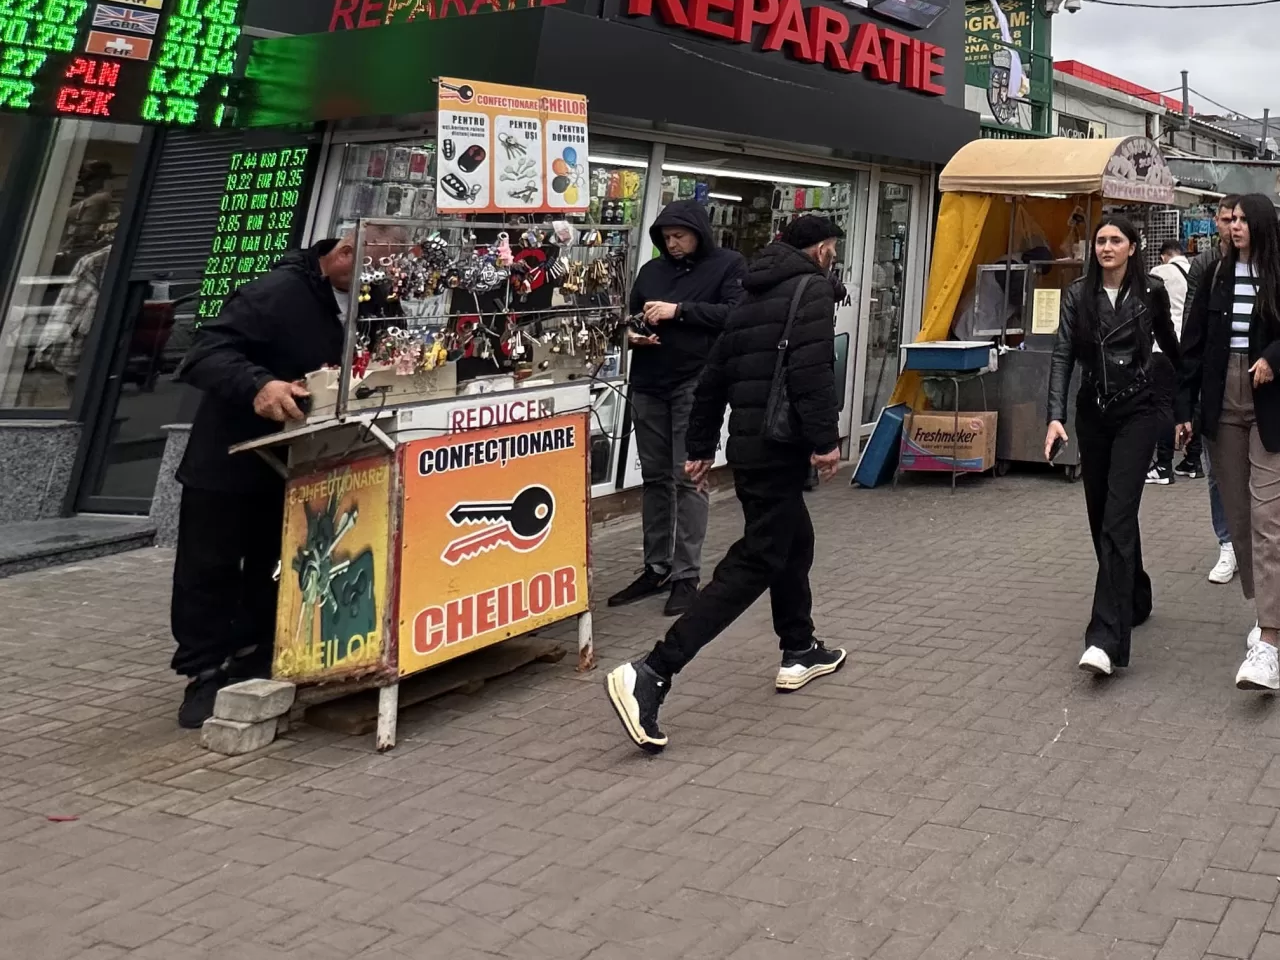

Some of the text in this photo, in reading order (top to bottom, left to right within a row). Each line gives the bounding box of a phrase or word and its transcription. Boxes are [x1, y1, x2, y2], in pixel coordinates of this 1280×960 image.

[965, 11, 1030, 32] GRM:
[110, 19, 141, 32] GBP
[166, 14, 242, 50] 22.87
[103, 46, 133, 57] CHF
[57, 86, 116, 117] CZK
[477, 95, 587, 115] CONFECȚIONARE CHEILOR
[452, 115, 485, 126] PENTRU
[509, 120, 538, 130] PENTRU
[559, 124, 585, 134] PENTRU
[525, 131, 537, 141] UȘI
[552, 134, 585, 143] DOMOFON
[230, 148, 309, 171] 17.44 USD 17.57
[226, 169, 304, 191] 19.22 EUR 19.35
[221, 193, 248, 212] 0.170
[270, 190, 299, 209] 0.190
[216, 214, 242, 233] 3.85
[268, 211, 294, 230] 3.92
[212, 235, 237, 254] 0.40
[263, 232, 290, 251] 0.45
[204, 256, 236, 275] 22.67
[200, 278, 232, 297] 20.25
[198, 299, 224, 318] 4.27
[418, 427, 575, 475] CONFECȚIONARE
[412, 566, 577, 655] CHEILOR
